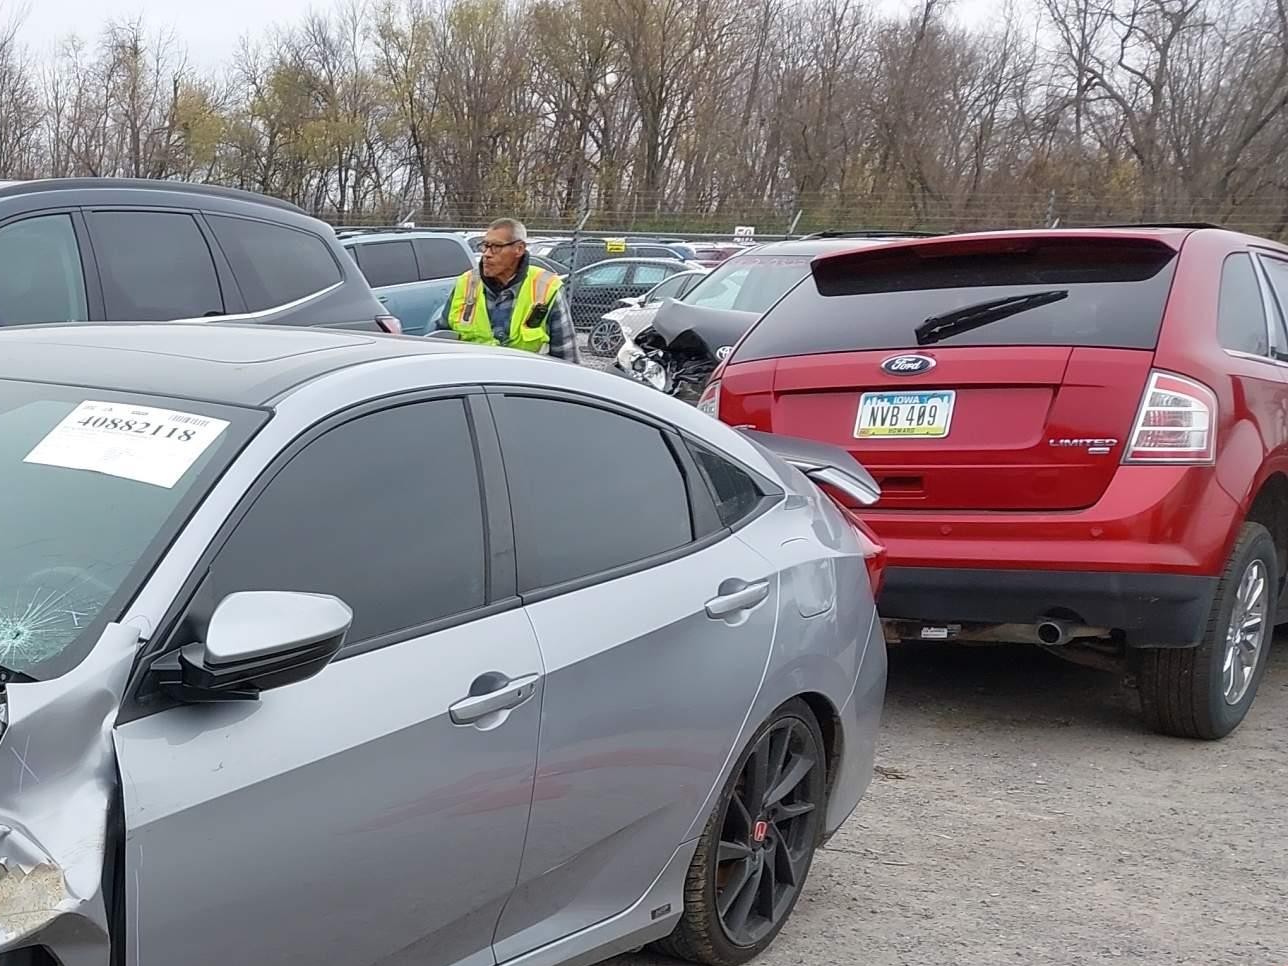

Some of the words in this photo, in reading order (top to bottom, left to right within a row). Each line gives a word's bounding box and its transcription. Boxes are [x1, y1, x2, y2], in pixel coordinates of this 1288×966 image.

[891, 357, 923, 370] Ford
[893, 395, 921, 404] IOWA
[868, 405, 900, 427] NVB
[905, 404, 938, 427] 409
[77, 415, 197, 442] 40882118
[1049, 438, 1118, 447] LIMITED
